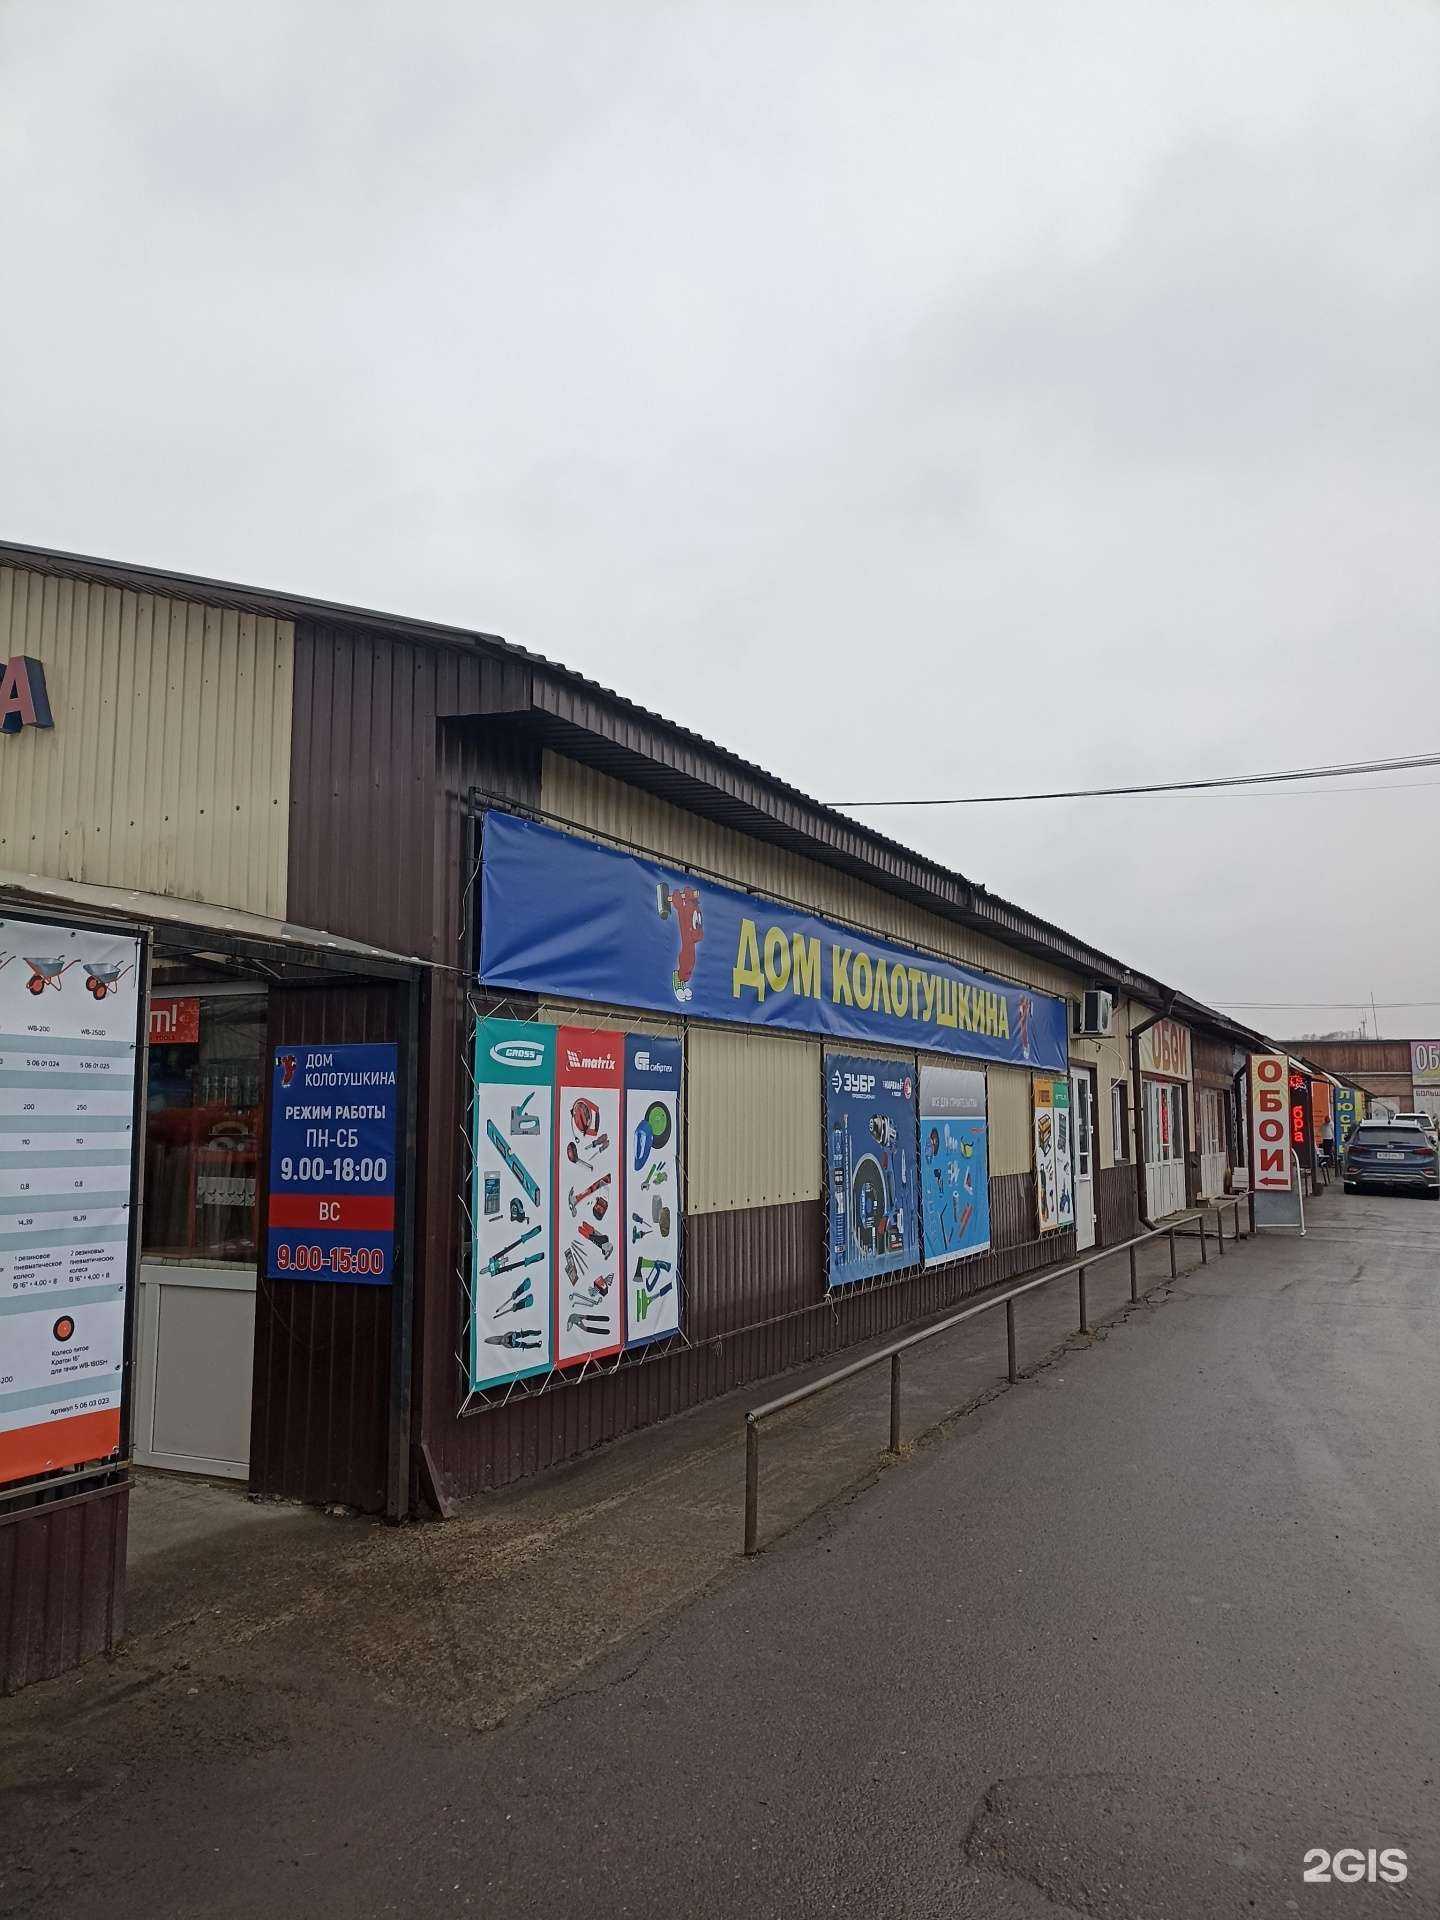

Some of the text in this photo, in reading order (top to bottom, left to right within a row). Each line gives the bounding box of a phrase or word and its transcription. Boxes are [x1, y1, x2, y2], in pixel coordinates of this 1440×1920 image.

[733, 917, 1011, 1041] ДОМ КОЛОТУШКИНА
[506, 1048, 535, 1058] GROSS
[1152, 1019, 1188, 1076] ОБОИ
[306, 1054, 333, 1068] ДОМ
[581, 1054, 616, 1070] matrix
[305, 1072, 396, 1087] КОЛОТУШКИНА
[844, 1073, 876, 1092] ЗУБР
[286, 1105, 386, 1120] РЕЖИМ РАБОТЫ
[1257, 1060, 1284, 1172] ОБОИ
[306, 1128, 359, 1148] ПН-СБ
[281, 1157, 387, 1182] 9.00-18:00
[319, 1202, 341, 1221] ВС
[277, 1244, 384, 1275] 9.00-15:00
[50, 1406, 73, 1416] Артикул
